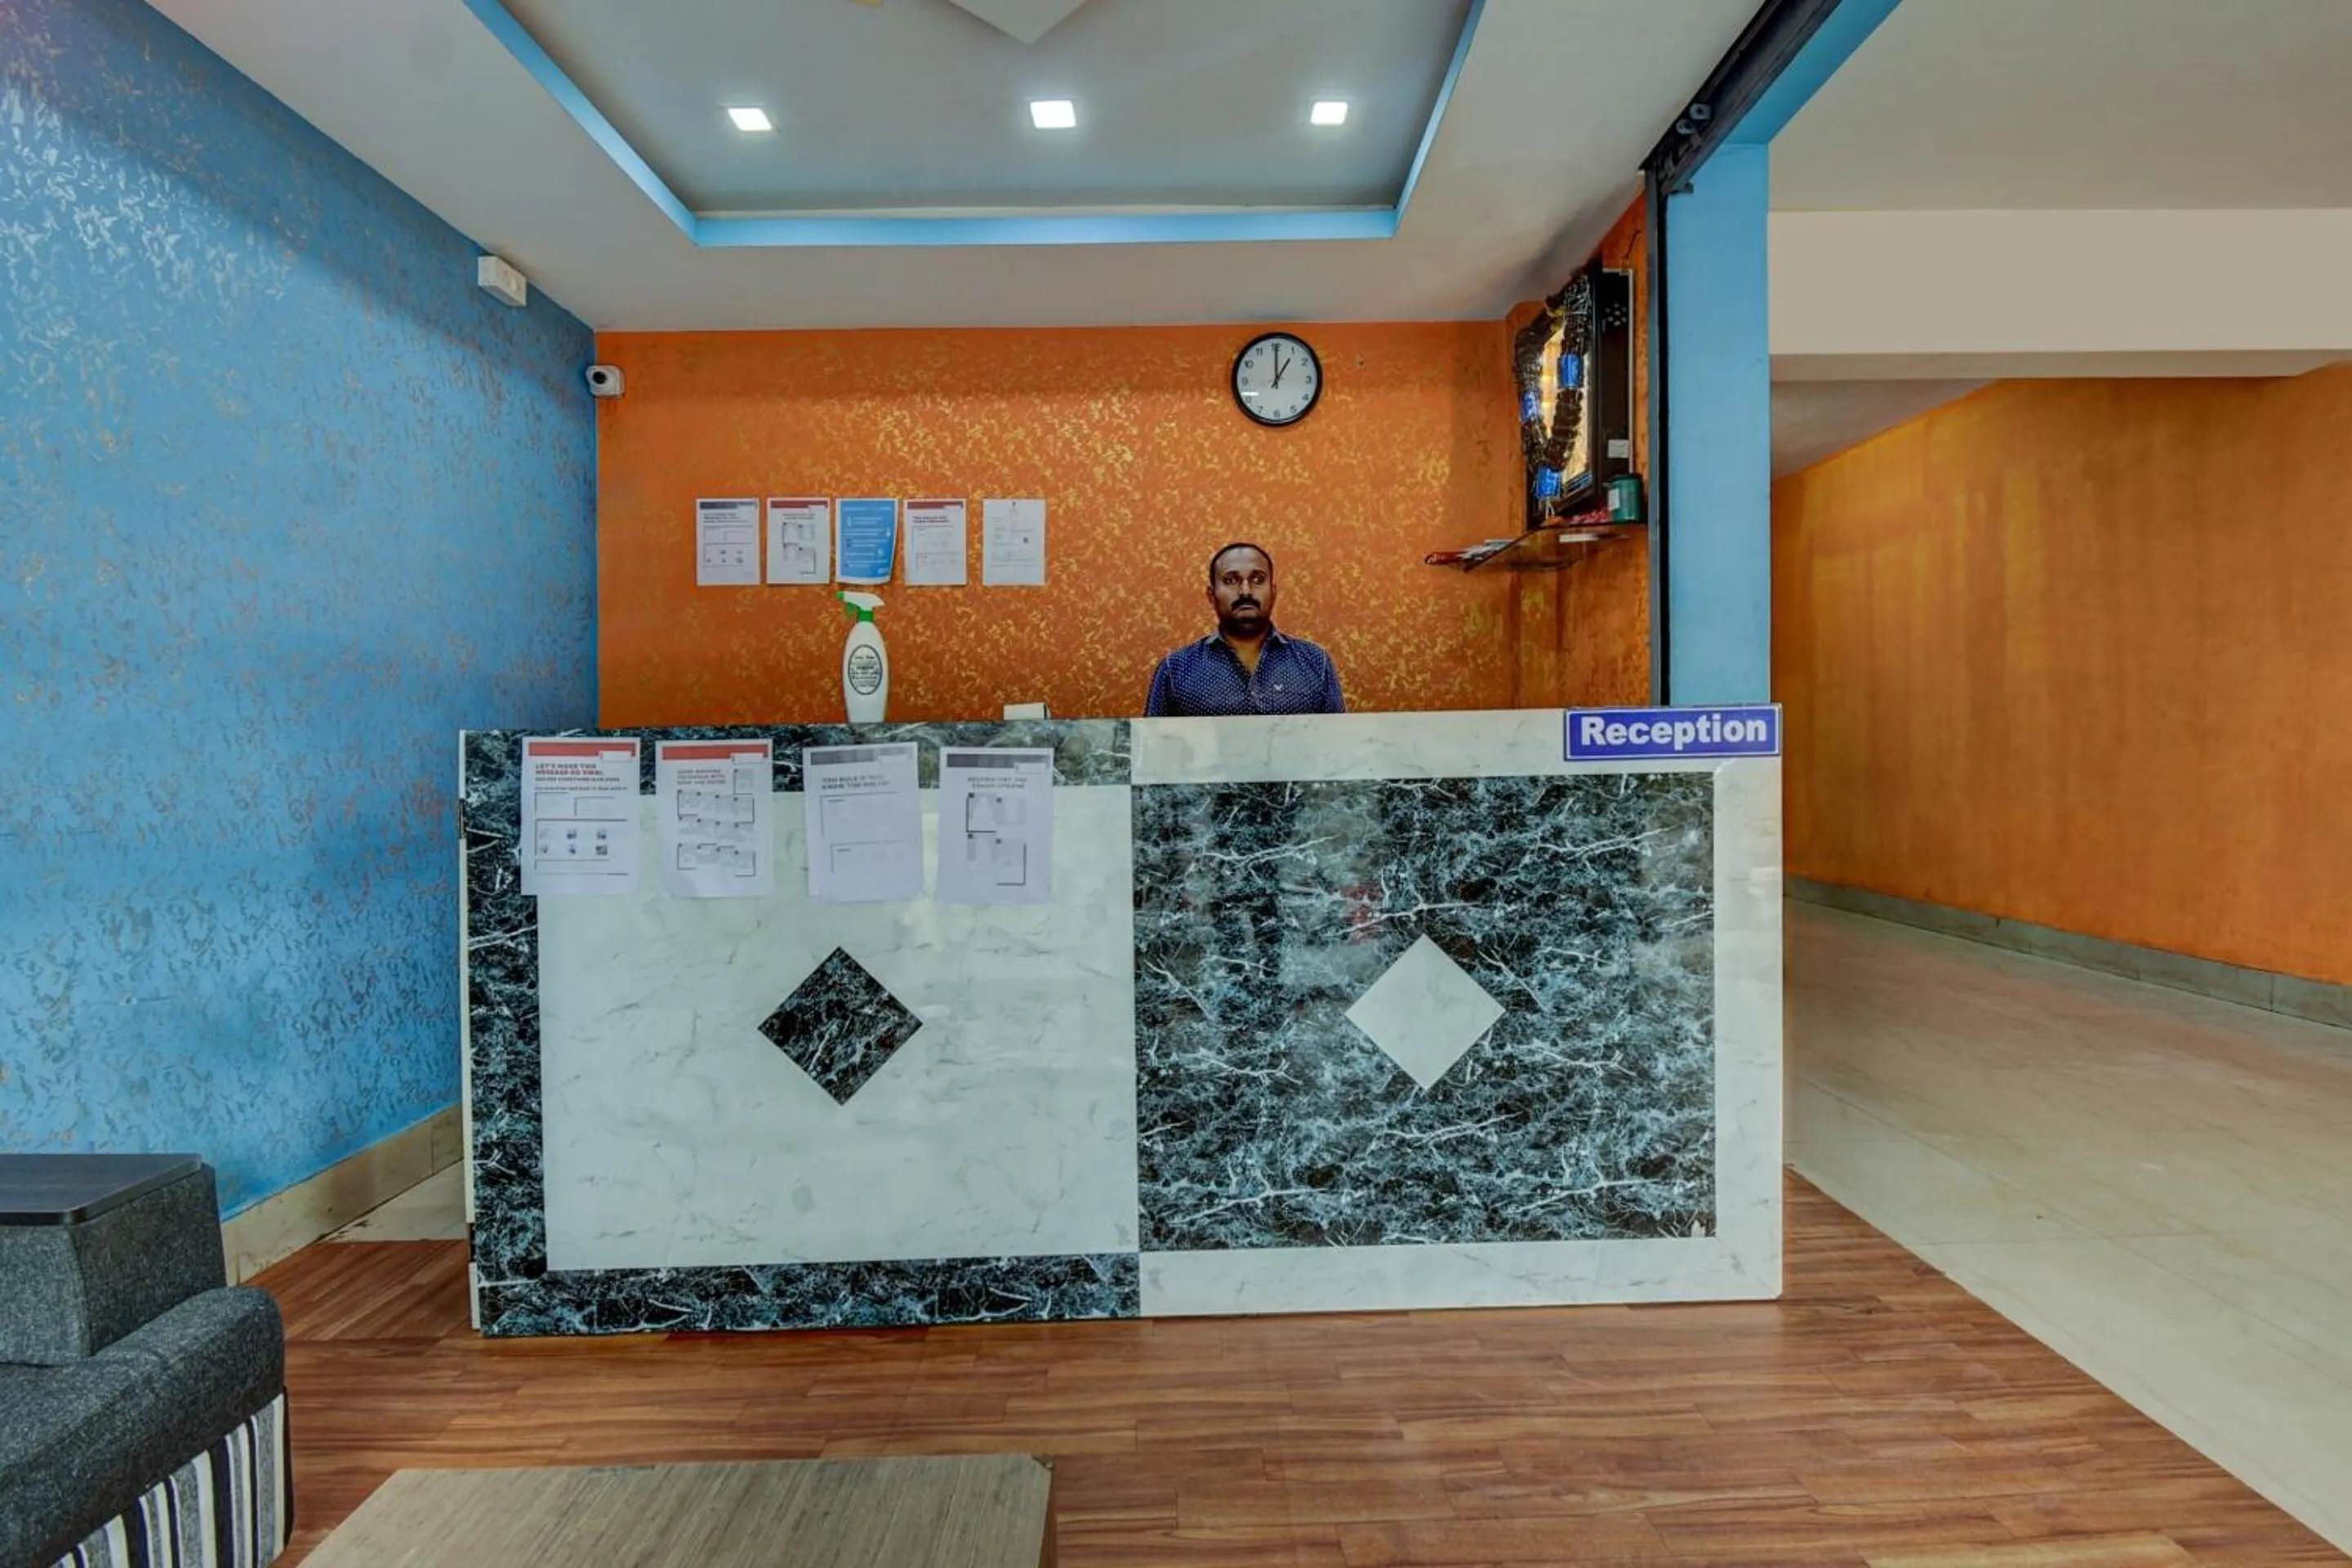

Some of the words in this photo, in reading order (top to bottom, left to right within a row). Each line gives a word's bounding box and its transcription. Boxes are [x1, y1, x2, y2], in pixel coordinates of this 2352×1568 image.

[1255, 347, 1263, 355] 11
[1290, 346, 1295, 354] 1
[1244, 359, 1254, 368] 10
[1302, 358, 1308, 367] 2
[1241, 376, 1248, 385] 9
[1305, 376, 1312, 384] 3
[1257, 406, 1263, 414] 7
[1290, 405, 1297, 413] 5
[1273, 410, 1280, 418] 6
[1580, 714, 1766, 751] Reception
